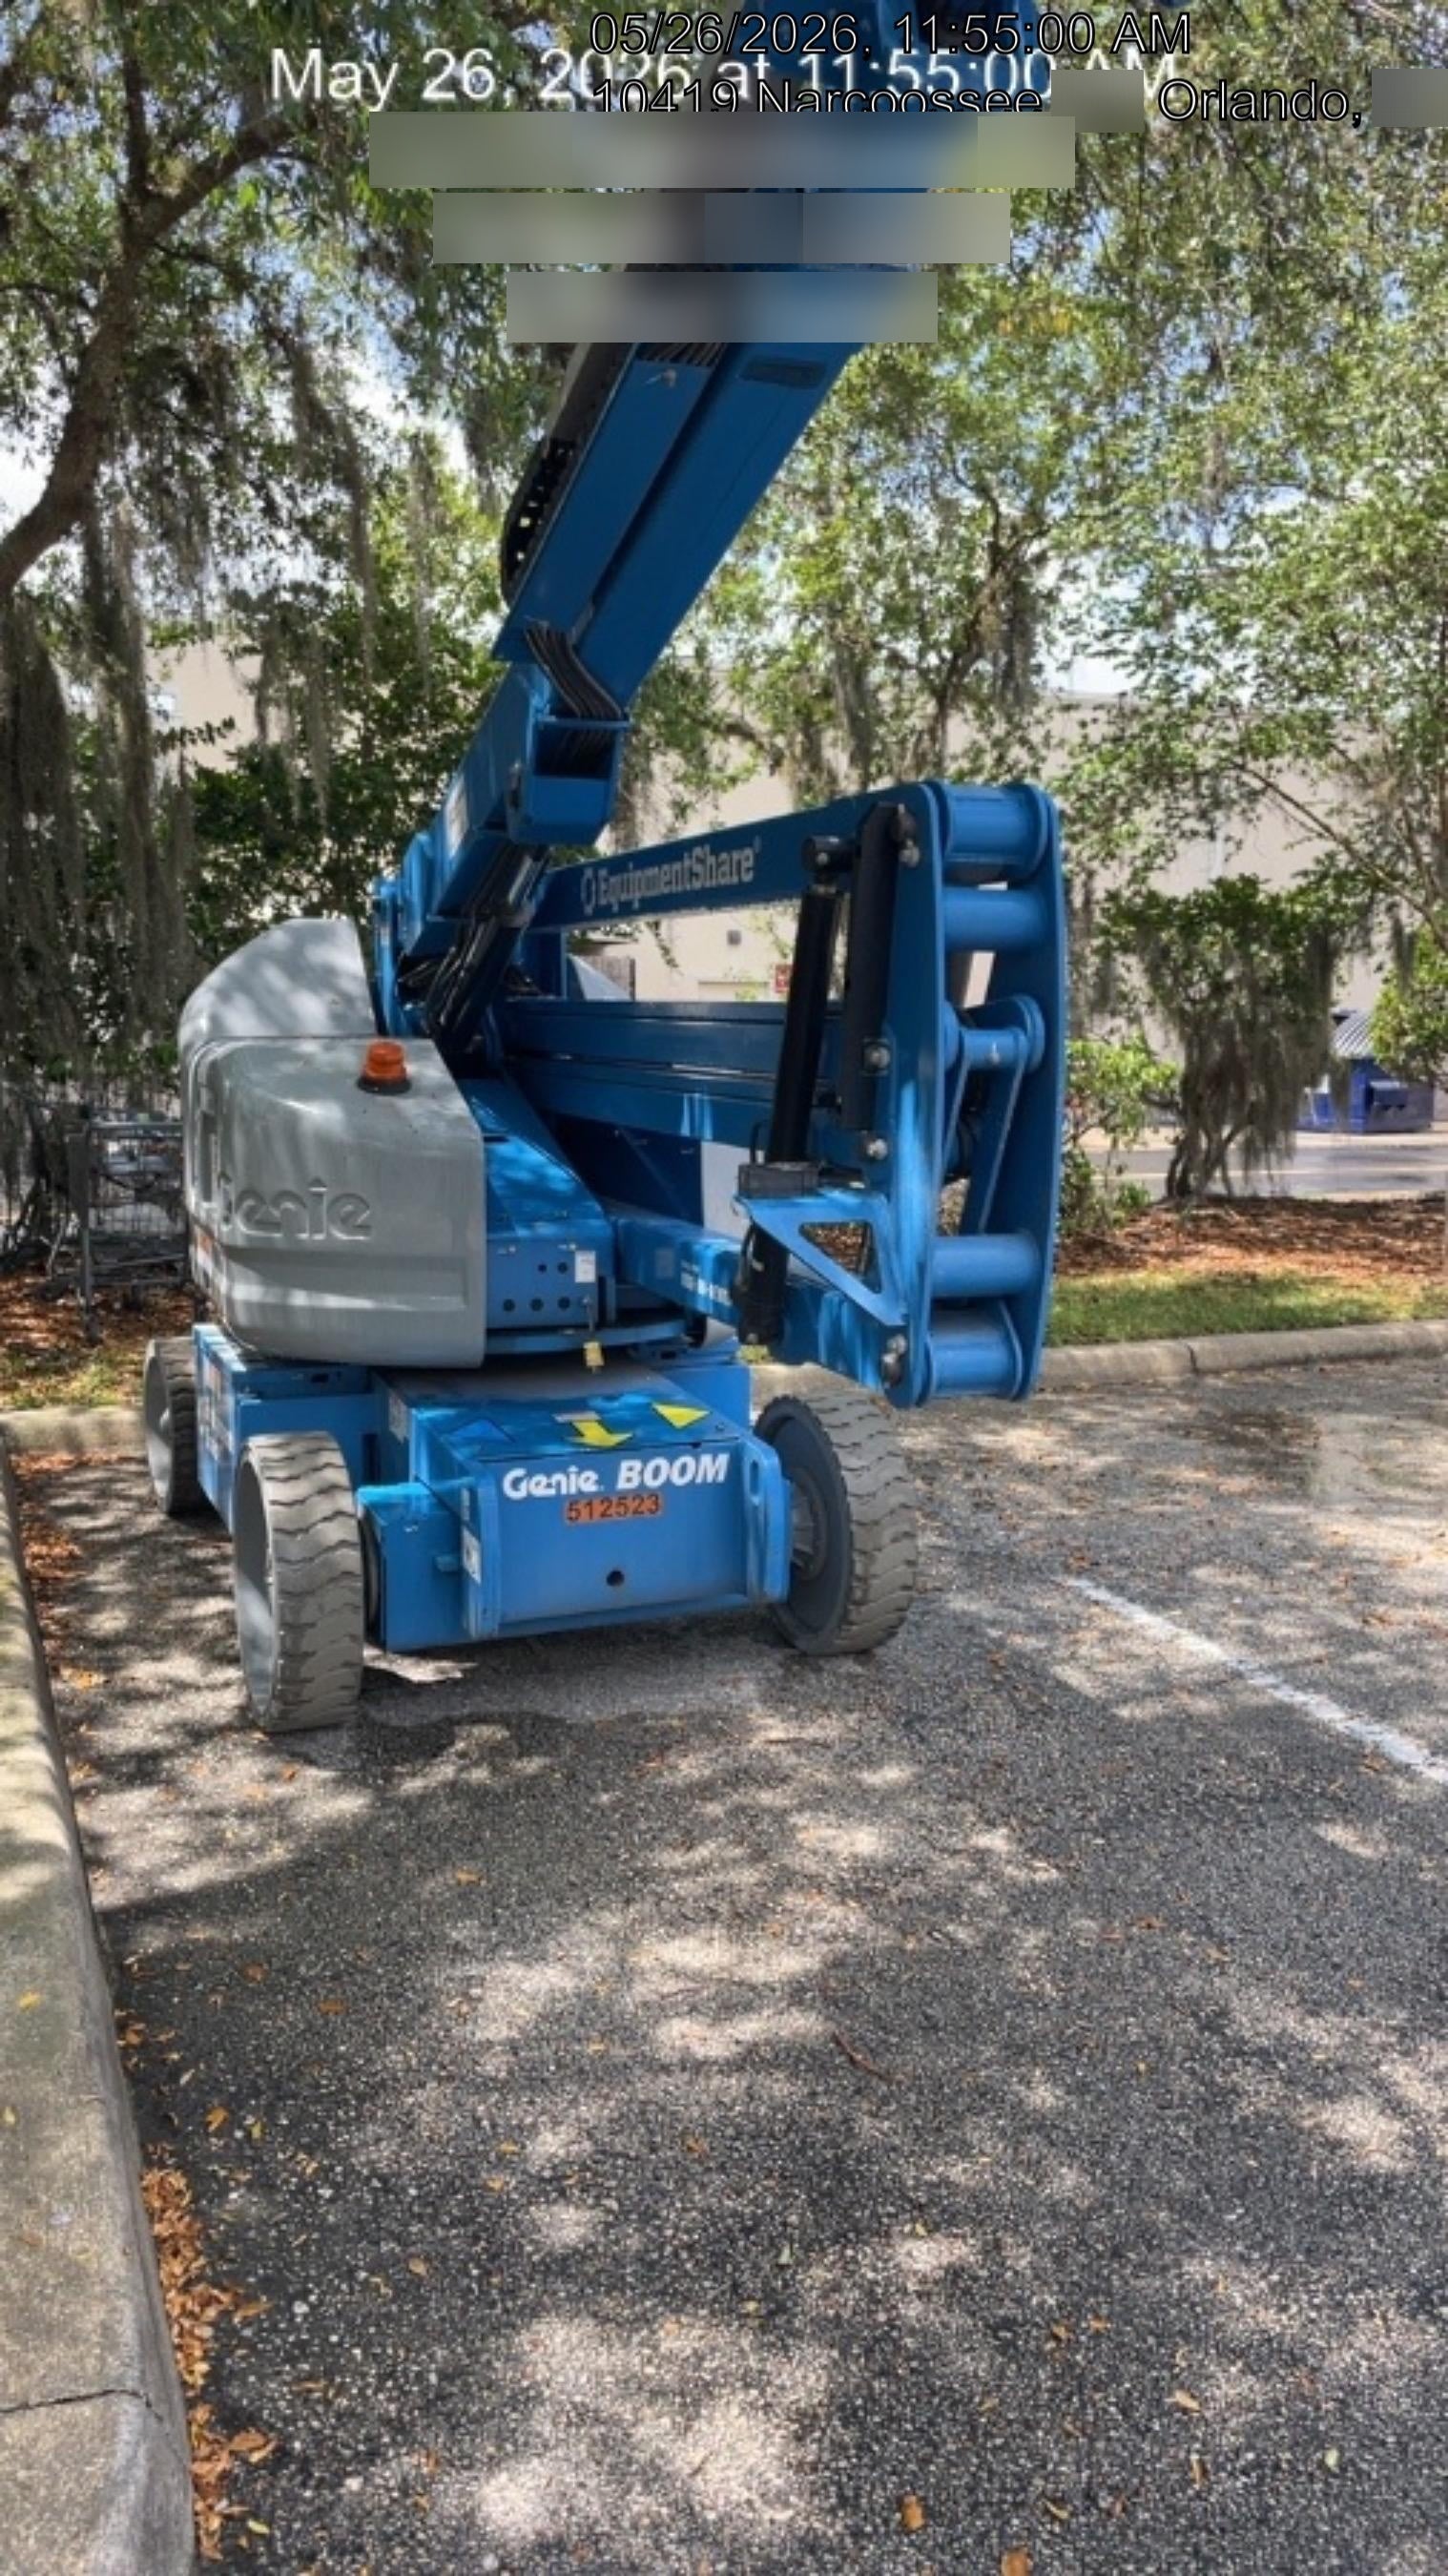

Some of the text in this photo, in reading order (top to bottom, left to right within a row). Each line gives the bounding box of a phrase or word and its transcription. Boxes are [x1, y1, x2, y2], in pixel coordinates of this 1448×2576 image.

[596, 843, 755, 913] EquipmentShare
[502, 1453, 731, 1501] Genie BOOM
[567, 1492, 662, 1523] 512523
